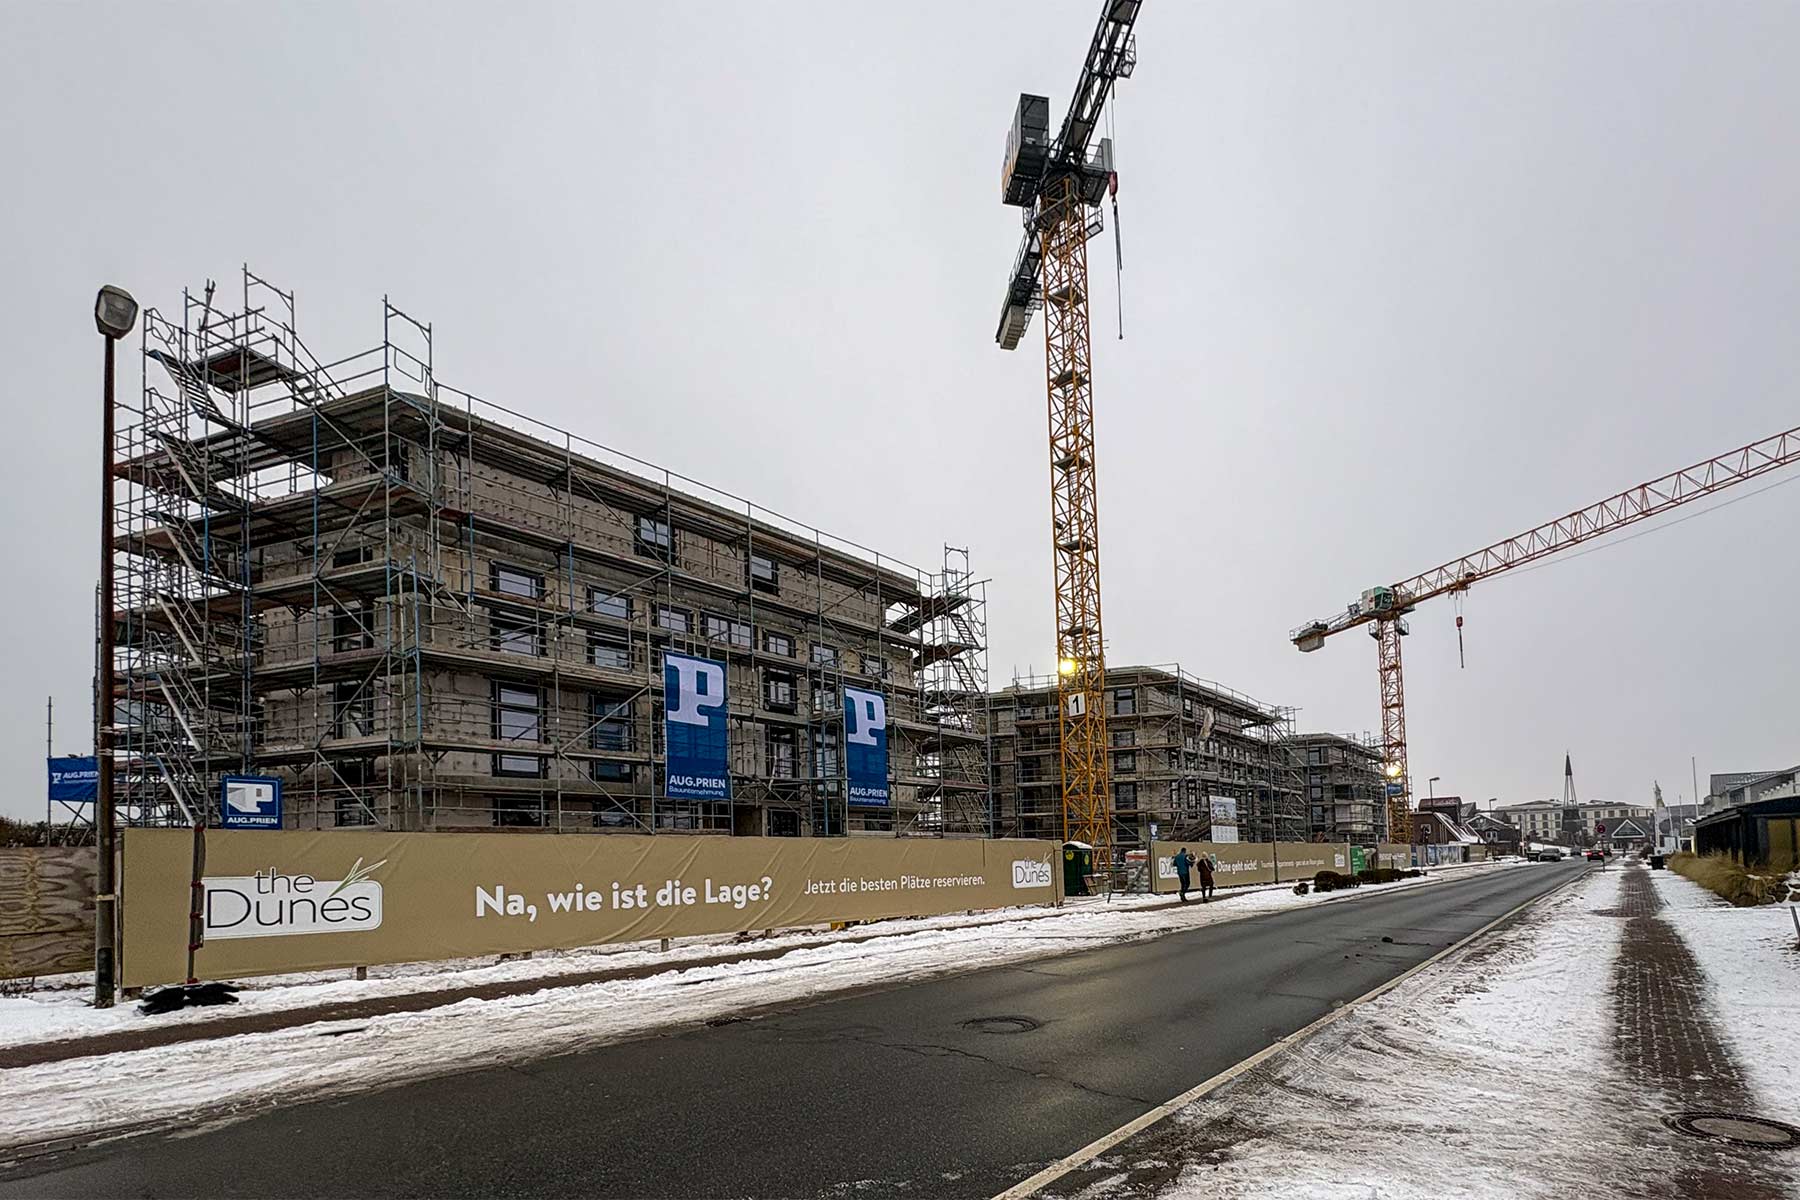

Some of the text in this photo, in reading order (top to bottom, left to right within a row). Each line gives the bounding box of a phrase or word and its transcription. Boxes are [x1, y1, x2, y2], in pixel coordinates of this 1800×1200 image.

[666, 655, 724, 727] P
[1072, 695, 1080, 713] 1
[845, 688, 886, 746] P
[669, 774, 726, 788] AUG.PRIEN
[849, 786, 888, 798] AUG.PRIEN
[227, 816, 278, 824] AUG.PRIEN
[254, 867, 314, 895] the
[804, 875, 985, 895] Jetzt die besten Plätze reservieren.
[1015, 866, 1050, 884] Dunes
[206, 888, 372, 929] Dunes
[475, 876, 773, 922] Na, wie ist die Lage?
